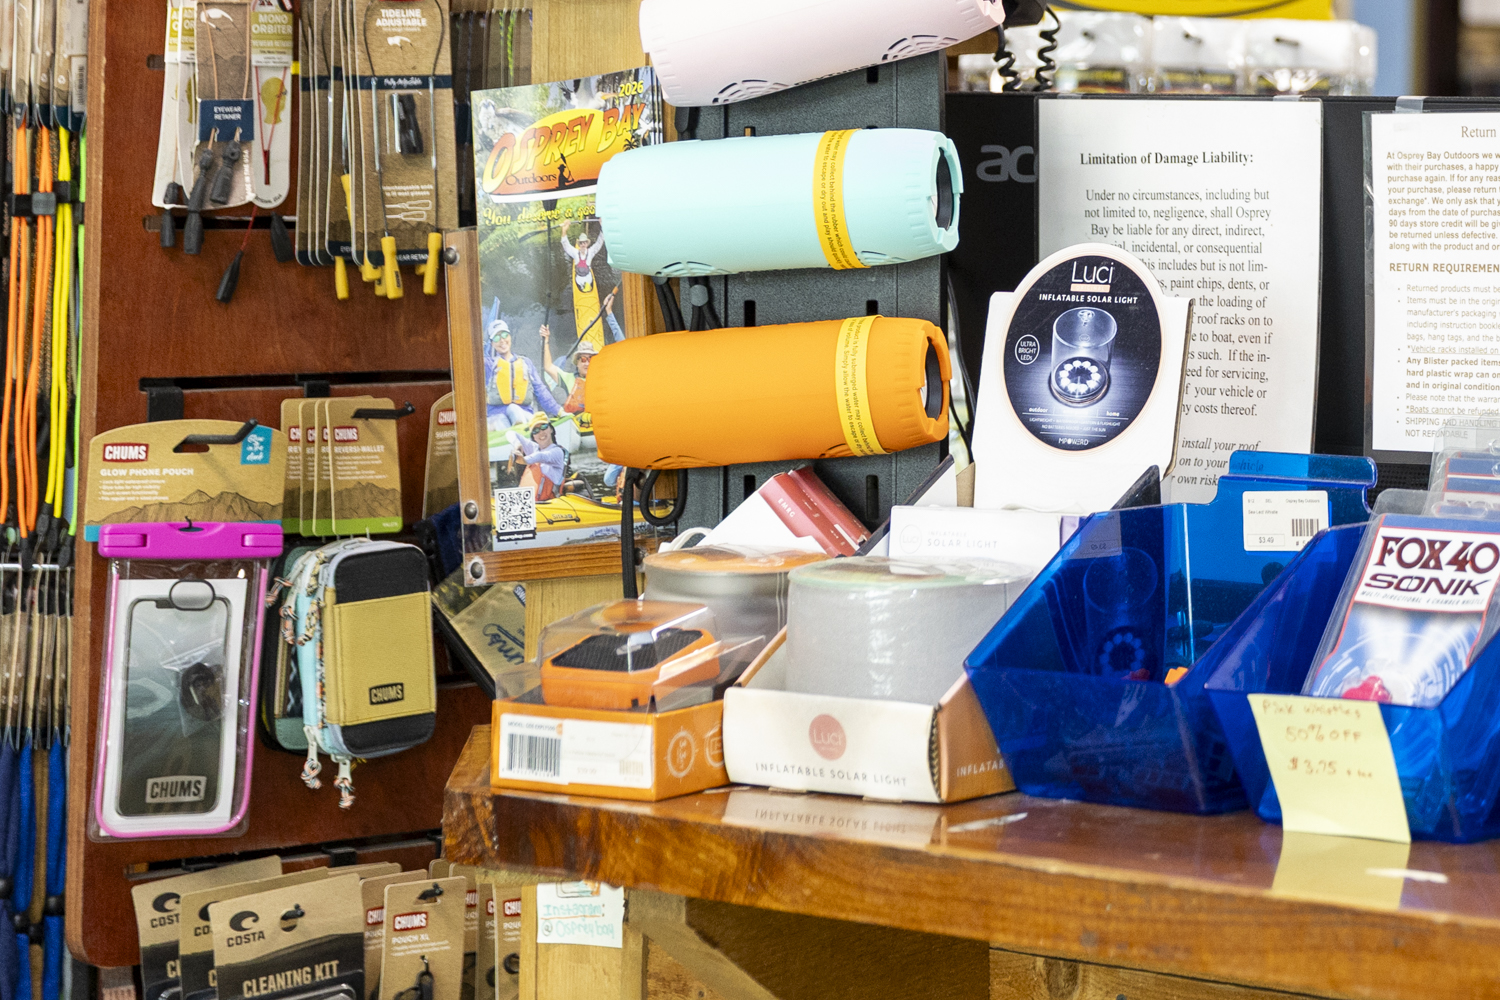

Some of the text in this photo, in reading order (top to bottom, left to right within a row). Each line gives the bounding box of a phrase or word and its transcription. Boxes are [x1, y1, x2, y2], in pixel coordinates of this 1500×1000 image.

[258, 14, 289, 23] MONO
[380, 8, 422, 18] TIDELINE
[251, 24, 293, 35] ORBITER
[375, 18, 428, 27] ADJUSTABLE
[618, 80, 644, 98] 2026
[1461, 125, 1497, 138] Return
[482, 102, 647, 194] OSPREY BAY
[1386, 151, 1395, 160] At
[1396, 150, 1425, 162] Osprey
[1426, 150, 1442, 162] Bay
[1443, 150, 1480, 160] Outdoors
[975, 144, 1037, 184] ac
[1080, 151, 1253, 167] Limitation of Damage Liability:
[1424, 162, 1467, 172] purchases,
[505, 172, 558, 187] Outdoors
[1086, 188, 1270, 204] Under no circumstances, including but
[483, 207, 512, 226] You
[1084, 206, 1271, 221] not limited to, negligence, shall Osprey
[1131, 240, 1262, 256] incidental, or consequential
[1071, 261, 1115, 284] Luci
[1158, 258, 1268, 272] includes but is not lim-
[1389, 262, 1429, 272] RETURN
[1170, 276, 1270, 292] paint chips, dents, or
[1038, 293, 1138, 304] INFLATABLE SOLAR LIGHT
[1199, 294, 1268, 311] the loading of
[1018, 347, 1037, 355] BRIGHT
[1406, 356, 1422, 366] Any
[1423, 356, 1449, 365] Blister
[1450, 357, 1479, 367] packed
[1431, 381, 1462, 392] original
[1194, 402, 1257, 416] costs thereof.
[334, 427, 358, 441] CHUMS
[1058, 437, 1089, 446] MPOWERD
[104, 445, 147, 461] CHUMS
[1181, 437, 1237, 453] install your
[100, 467, 194, 477] GLOW PHONE POUCH
[777, 497, 796, 518] EMRG
[927, 538, 962, 548] SOLAR
[965, 539, 998, 549] LIGHT
[1374, 535, 1500, 575] FOX 40
[1364, 572, 1492, 596] SONIK
[371, 684, 403, 704] CHUMS
[812, 727, 842, 746] Luci
[755, 762, 908, 787] INFLATABLE SOLAR LIGHT
[956, 758, 1005, 778] INFLATAB
[150, 779, 202, 798] CHUMS
[150, 914, 181, 929] COST
[394, 913, 427, 930] CHUMS
[226, 931, 266, 948] COSTA
[242, 960, 340, 999] CLEANING KIT
